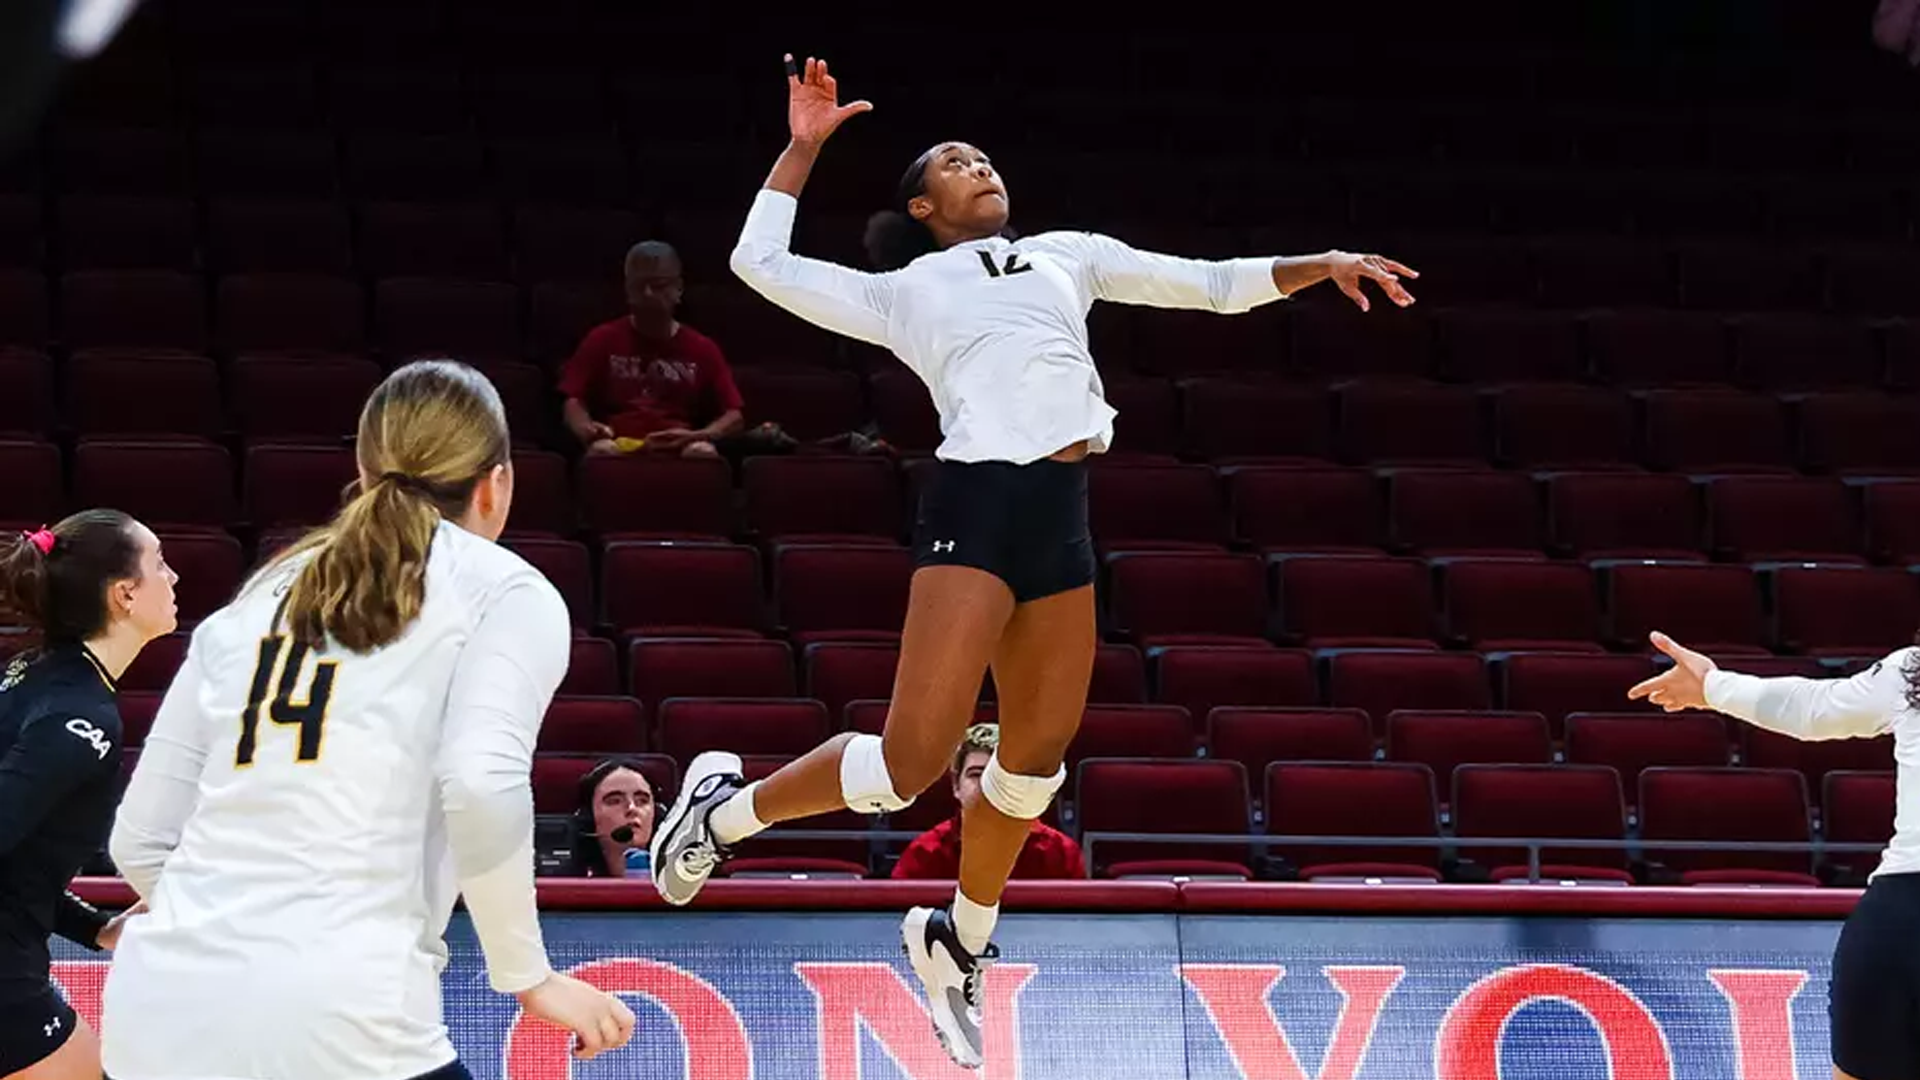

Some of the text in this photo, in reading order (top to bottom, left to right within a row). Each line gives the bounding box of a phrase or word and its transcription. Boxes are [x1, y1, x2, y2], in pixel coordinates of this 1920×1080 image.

[975, 250, 1033, 278] 12
[234, 632, 342, 771] 14
[65, 718, 112, 760] CAA
